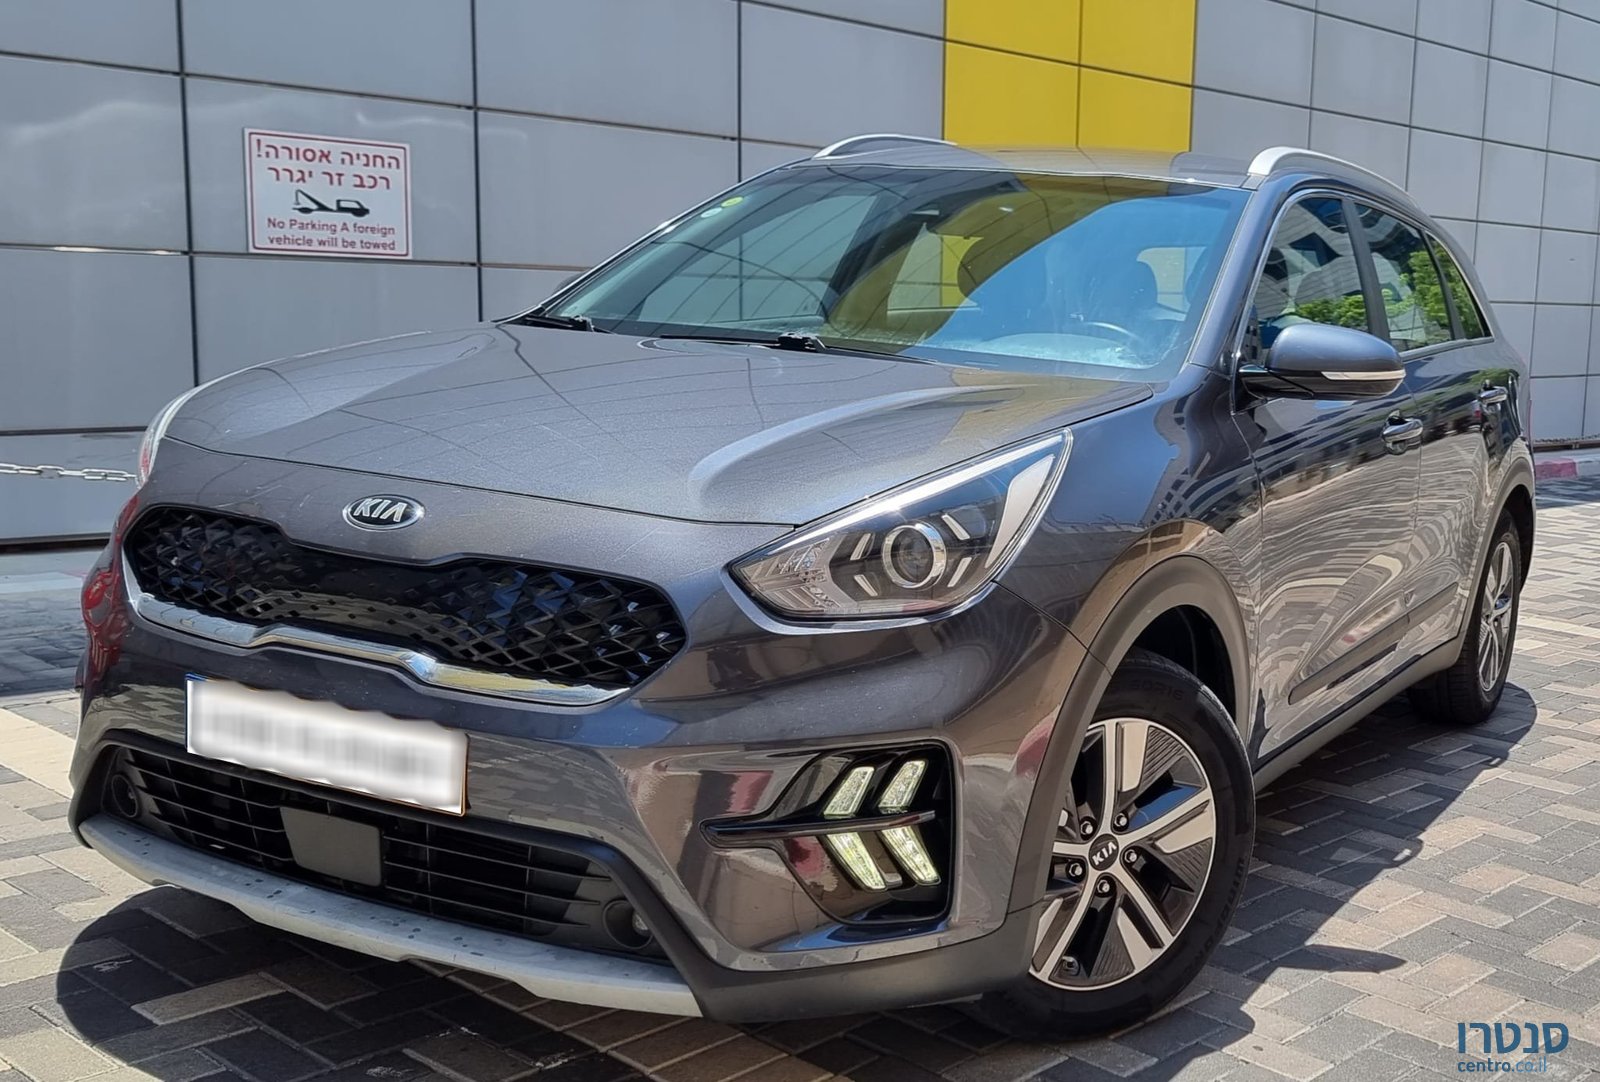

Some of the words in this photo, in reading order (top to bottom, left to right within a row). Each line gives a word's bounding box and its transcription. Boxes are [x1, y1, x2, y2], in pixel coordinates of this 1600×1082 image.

[256, 138, 332, 164] אסורה!
[340, 151, 400, 170] החניה
[267, 166, 313, 184] יגרר
[322, 171, 345, 187] זר
[352, 174, 391, 190] רכב
[267, 217, 285, 229] No
[289, 219, 337, 235] Parking
[340, 223, 350, 233] A
[353, 222, 395, 238] foreign
[268, 234, 314, 246] vehicle
[317, 237, 338, 248] will
[341, 238, 357, 249] be
[360, 239, 396, 251] towed
[353, 498, 408, 523] KIA
[1092, 841, 1118, 866] KIA
